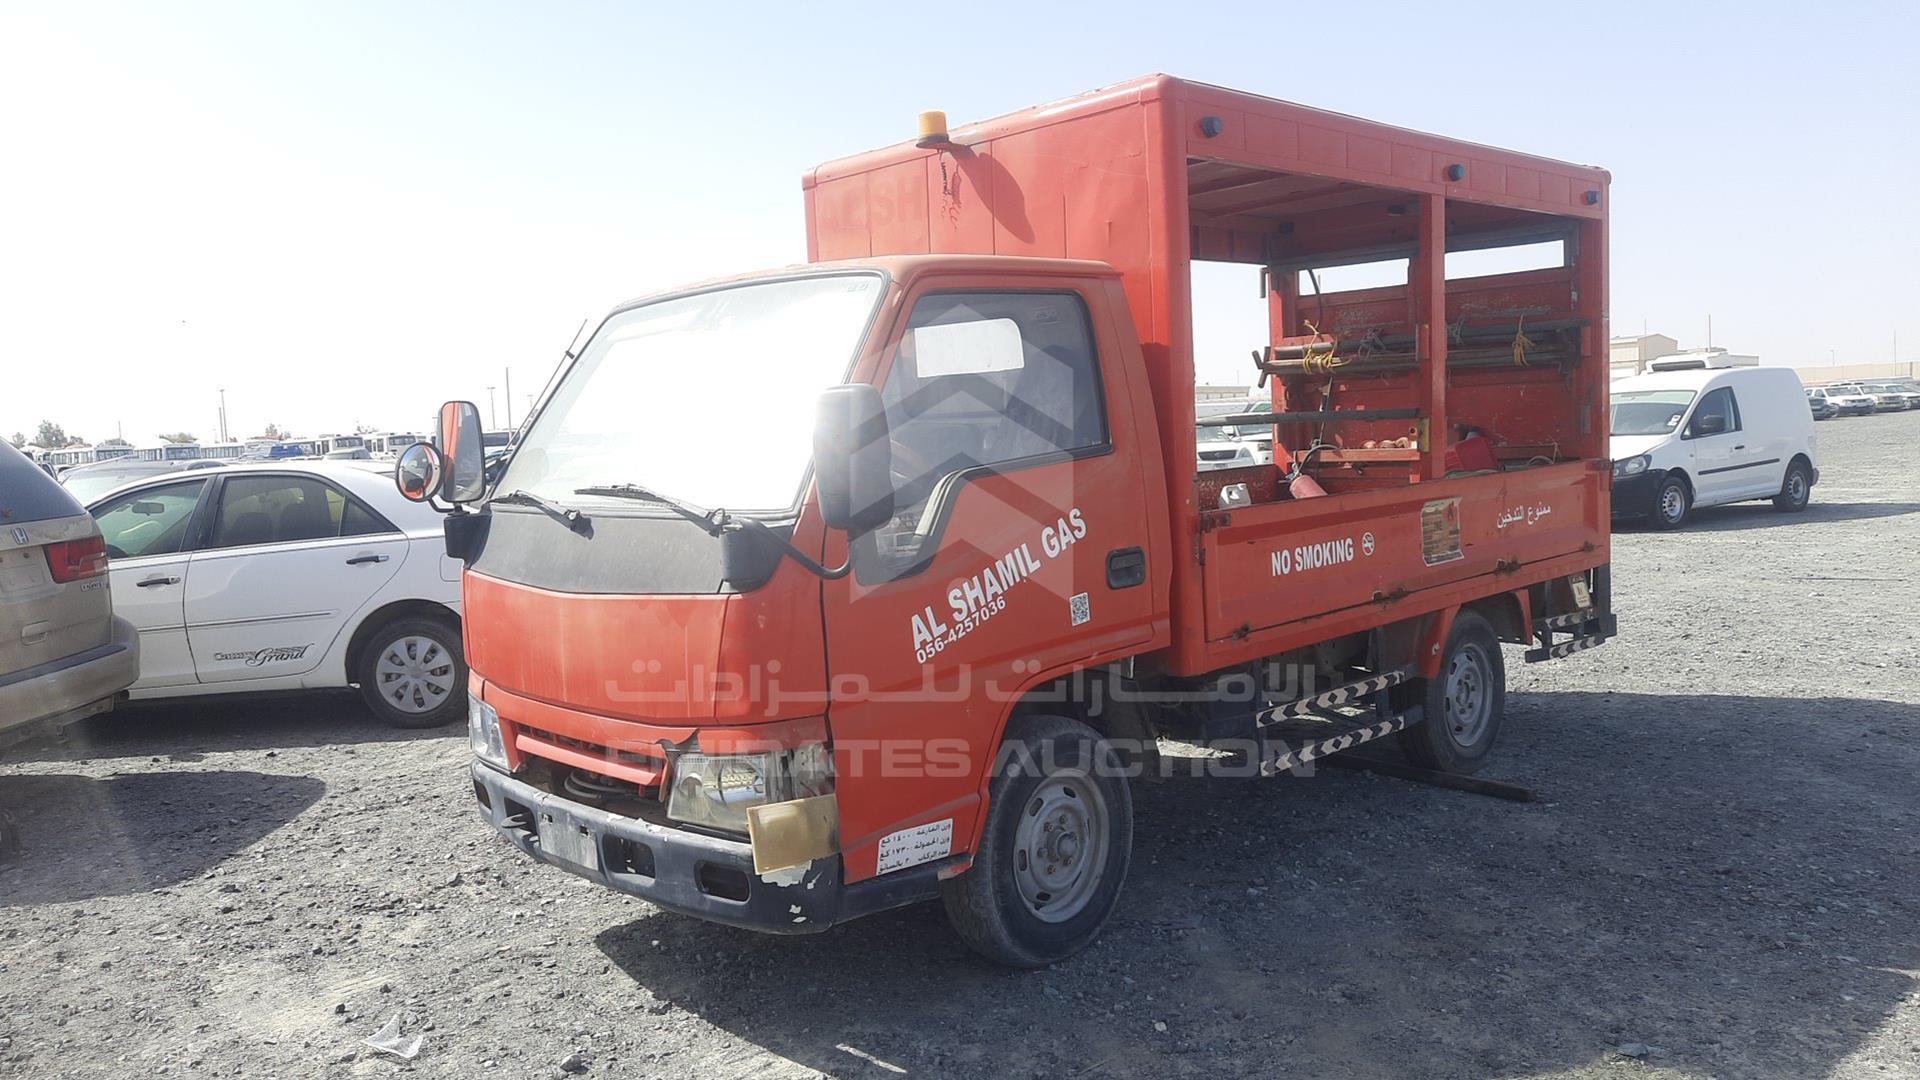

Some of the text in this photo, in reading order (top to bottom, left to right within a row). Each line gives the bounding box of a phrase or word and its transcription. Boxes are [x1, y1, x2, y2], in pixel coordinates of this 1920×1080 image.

[1496, 501, 1551, 528] ممنوع التدخين
[911, 508, 1087, 651] AL SHAMIL GAS
[1271, 538, 1354, 576] NO SMOKING
[916, 596, 1006, 664] 056-4257036
